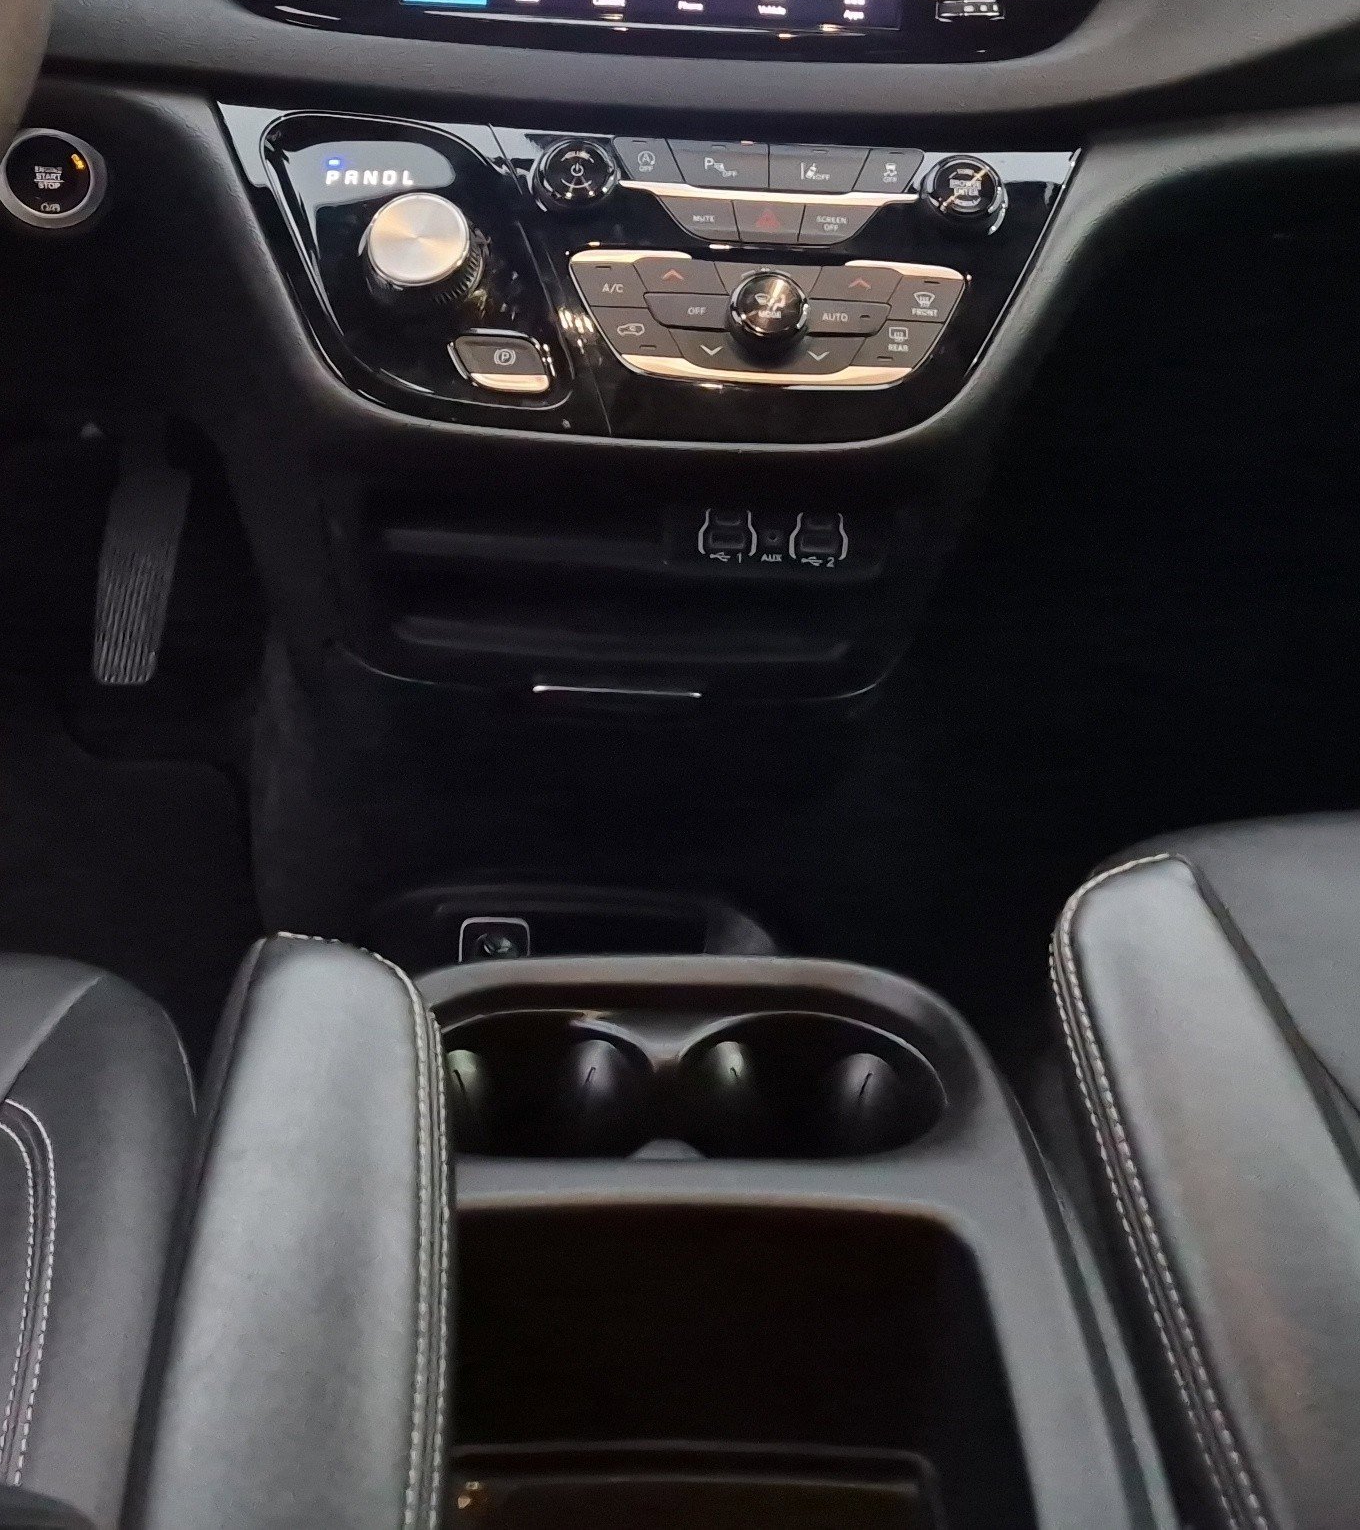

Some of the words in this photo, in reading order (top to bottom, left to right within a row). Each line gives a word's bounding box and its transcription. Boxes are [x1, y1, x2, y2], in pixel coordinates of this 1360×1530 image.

[723, 170, 738, 178] OFF
[816, 215, 847, 224] SCREEN
[823, 223, 839, 231] OFF
[602, 283, 624, 293] A/C
[688, 307, 706, 316] OFF
[911, 308, 938, 317] FRONT
[822, 312, 848, 322] AUTO
[888, 344, 909, 352] REAR
[761, 553, 782, 562] AUX
[826, 557, 835, 568] 2
